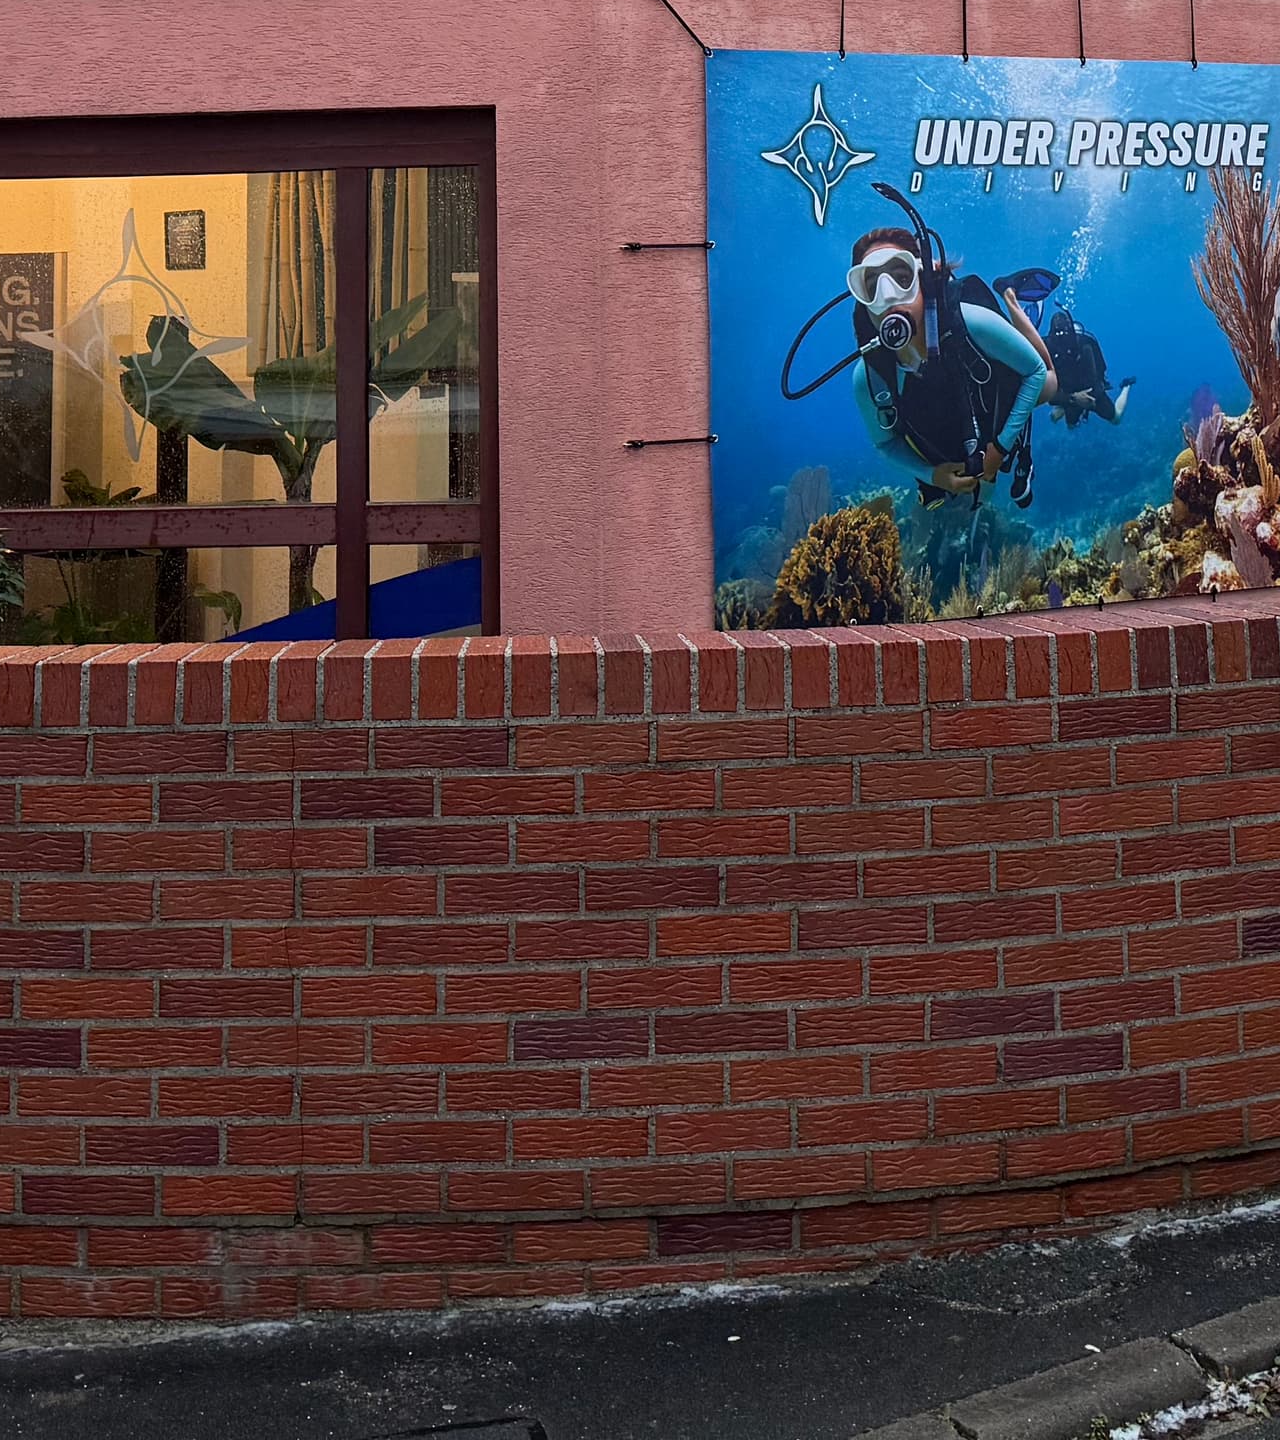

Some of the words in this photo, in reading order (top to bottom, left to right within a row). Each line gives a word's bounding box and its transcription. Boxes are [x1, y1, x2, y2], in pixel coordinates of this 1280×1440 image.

[914, 119, 1054, 166] UNDER
[1067, 120, 1269, 167] PRESSURE
[910, 171, 1263, 193] DIVING
